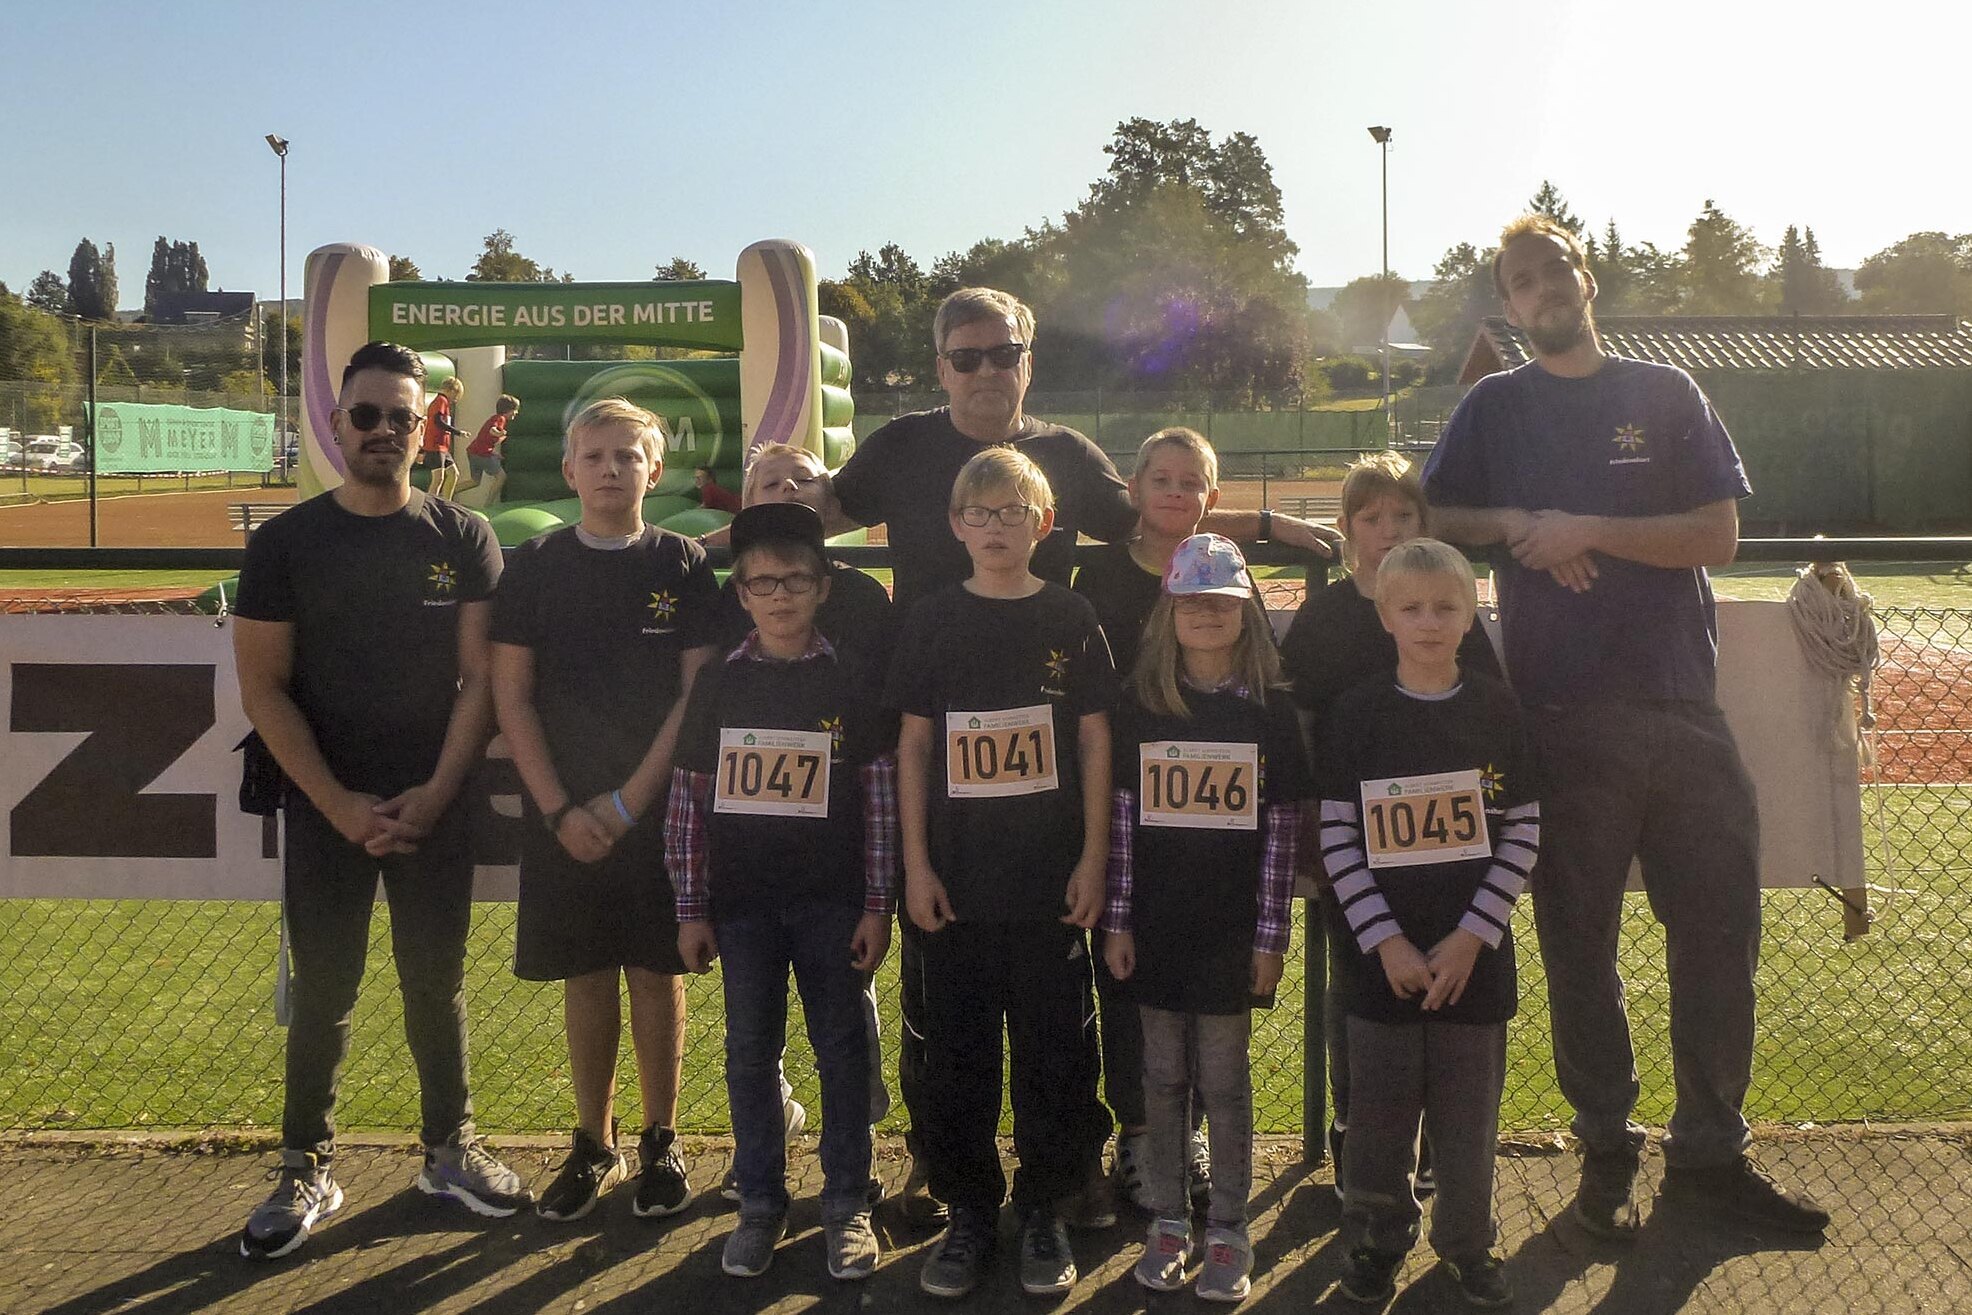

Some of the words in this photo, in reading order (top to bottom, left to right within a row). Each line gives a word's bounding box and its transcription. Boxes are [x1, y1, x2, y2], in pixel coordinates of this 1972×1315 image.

[392, 303, 506, 327] ENERGIE
[513, 305, 565, 327] AUS
[574, 304, 626, 325] DER
[633, 301, 714, 325] MITTE
[167, 428, 216, 448] MEYER
[726, 752, 820, 798] 1047
[957, 730, 1043, 779] 1041
[1148, 764, 1247, 811] 1046
[1371, 796, 1476, 849] 1045
